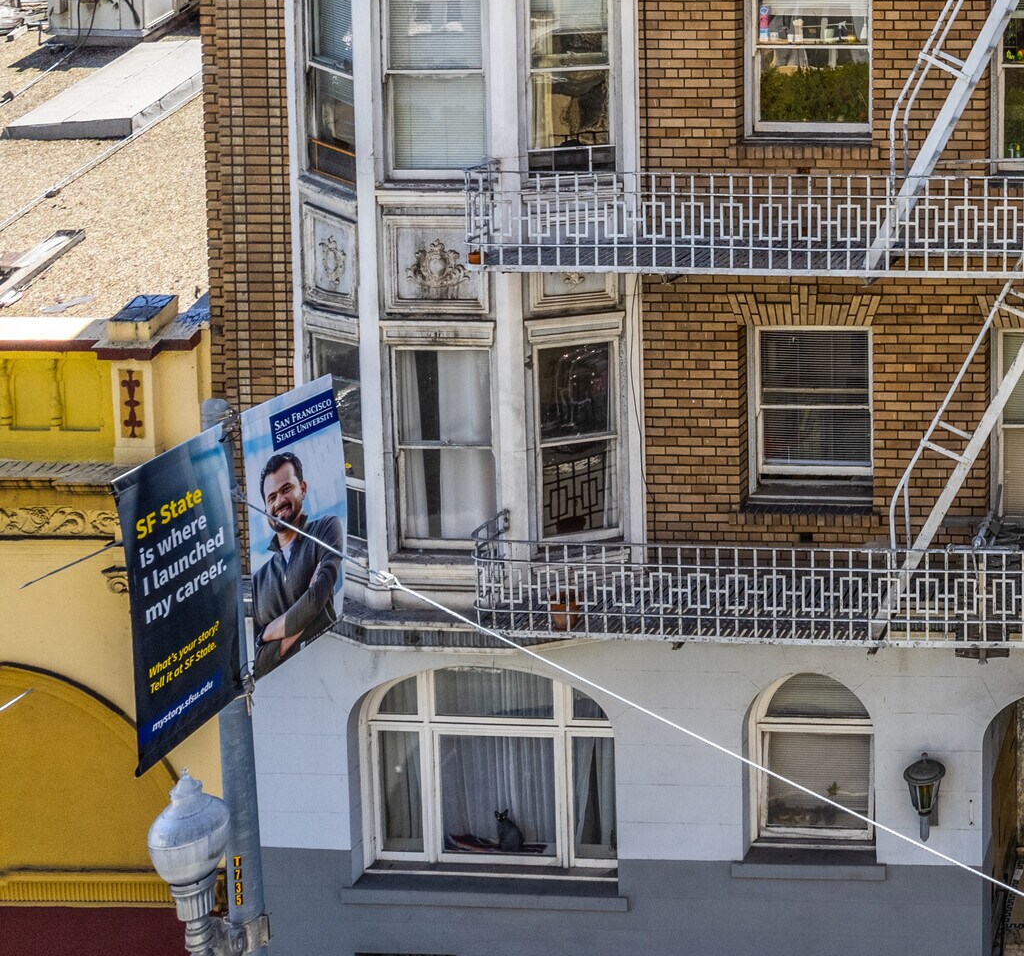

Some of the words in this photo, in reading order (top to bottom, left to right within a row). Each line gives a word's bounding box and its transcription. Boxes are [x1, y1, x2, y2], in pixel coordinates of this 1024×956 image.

[274, 417, 290, 431] SAN
[291, 398, 332, 423] FRANCISCO
[276, 428, 297, 443] STATE
[296, 410, 334, 434] UNIVERSITY
[135, 511, 156, 539] SF
[160, 489, 202, 525] State
[139, 547, 155, 568] is
[157, 514, 207, 556] where
[143, 576, 149, 596] I
[152, 526, 225, 589] launched
[145, 594, 172, 624] my
[175, 558, 227, 603] career.
[148, 652, 178, 678] What's
[178, 638, 197, 661] your
[197, 620, 220, 645] story?
[150, 677, 165, 694] Tell
[166, 670, 173, 683] it
[173, 664, 183, 677] at
[184, 654, 195, 670] SF
[195, 641, 217, 662] State.
[152, 680, 214, 733] mystory.sfsu.edu
